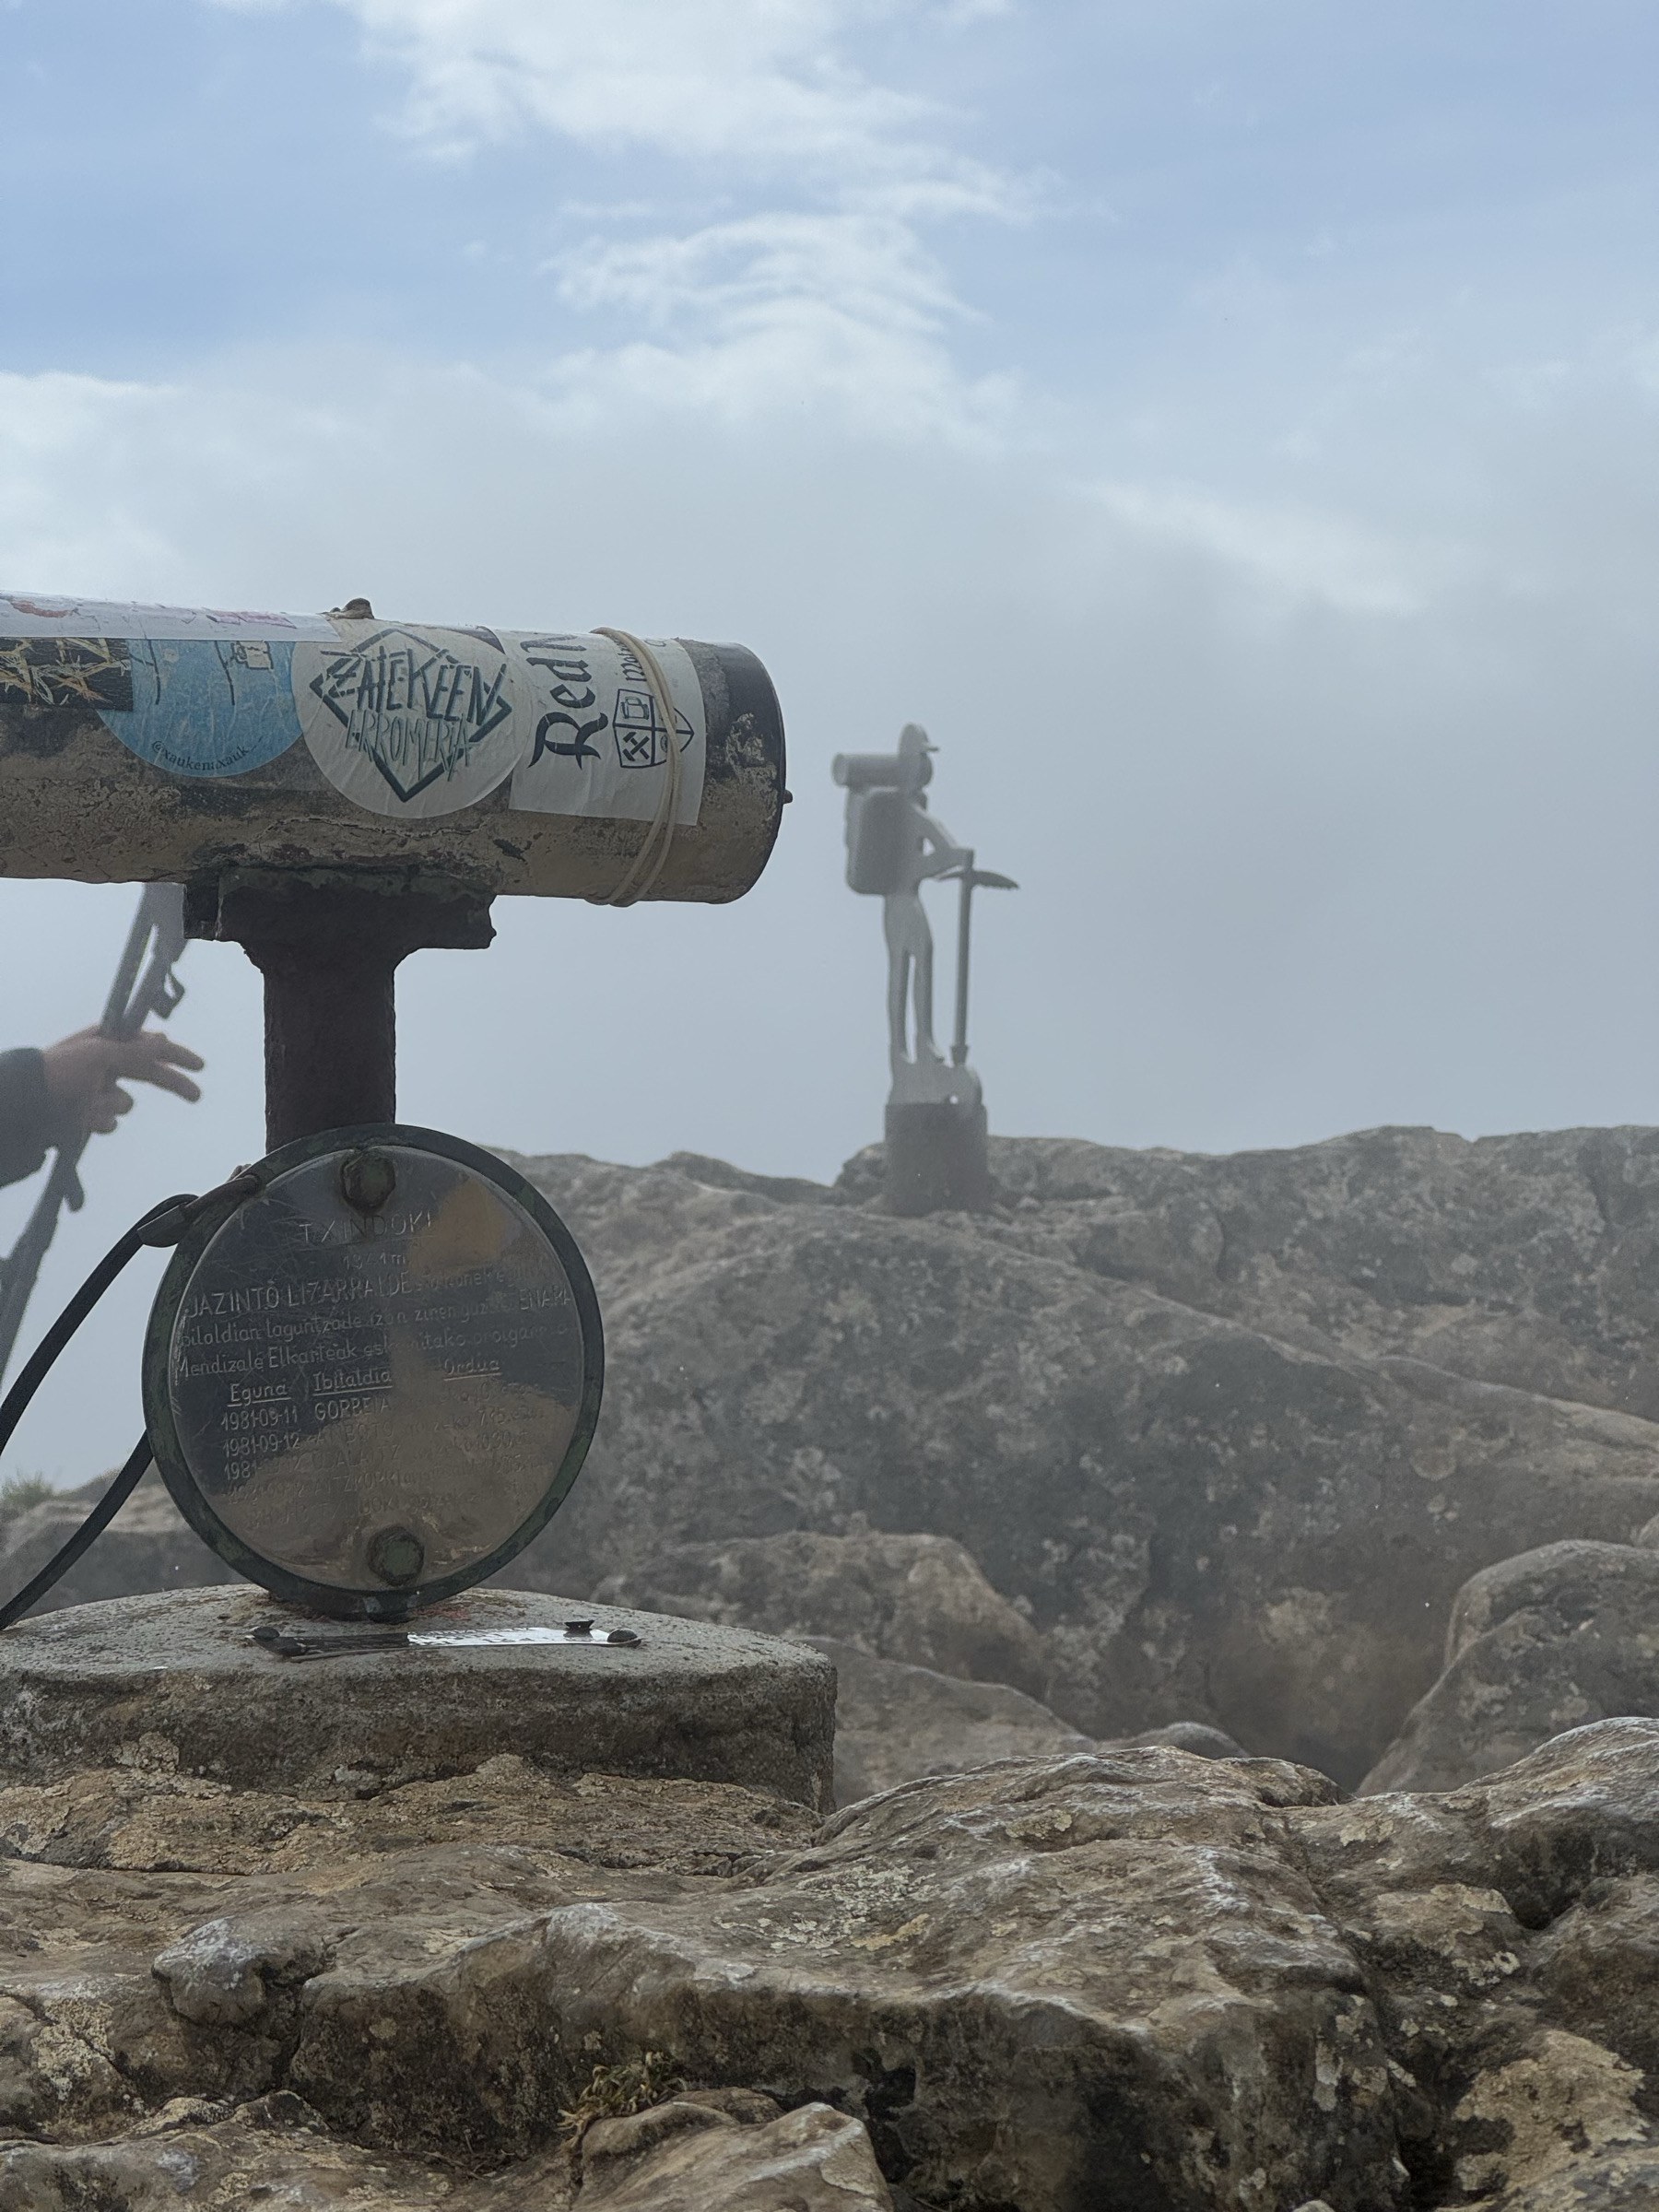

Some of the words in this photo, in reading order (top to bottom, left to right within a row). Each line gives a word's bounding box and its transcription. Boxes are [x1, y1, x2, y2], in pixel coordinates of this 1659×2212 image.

[321, 646, 506, 725] ZATEKEEN
[347, 710, 481, 782] ERROMERIA
[187, 1286, 280, 1319] JAZINTO
[268, 1338, 358, 1370] Elkarteak
[229, 1381, 288, 1406] Eguna
[443, 1357, 501, 1376] Ordua
[221, 1406, 298, 1431] 1981-09-11
[223, 1432, 300, 1458] 1981-09-12
